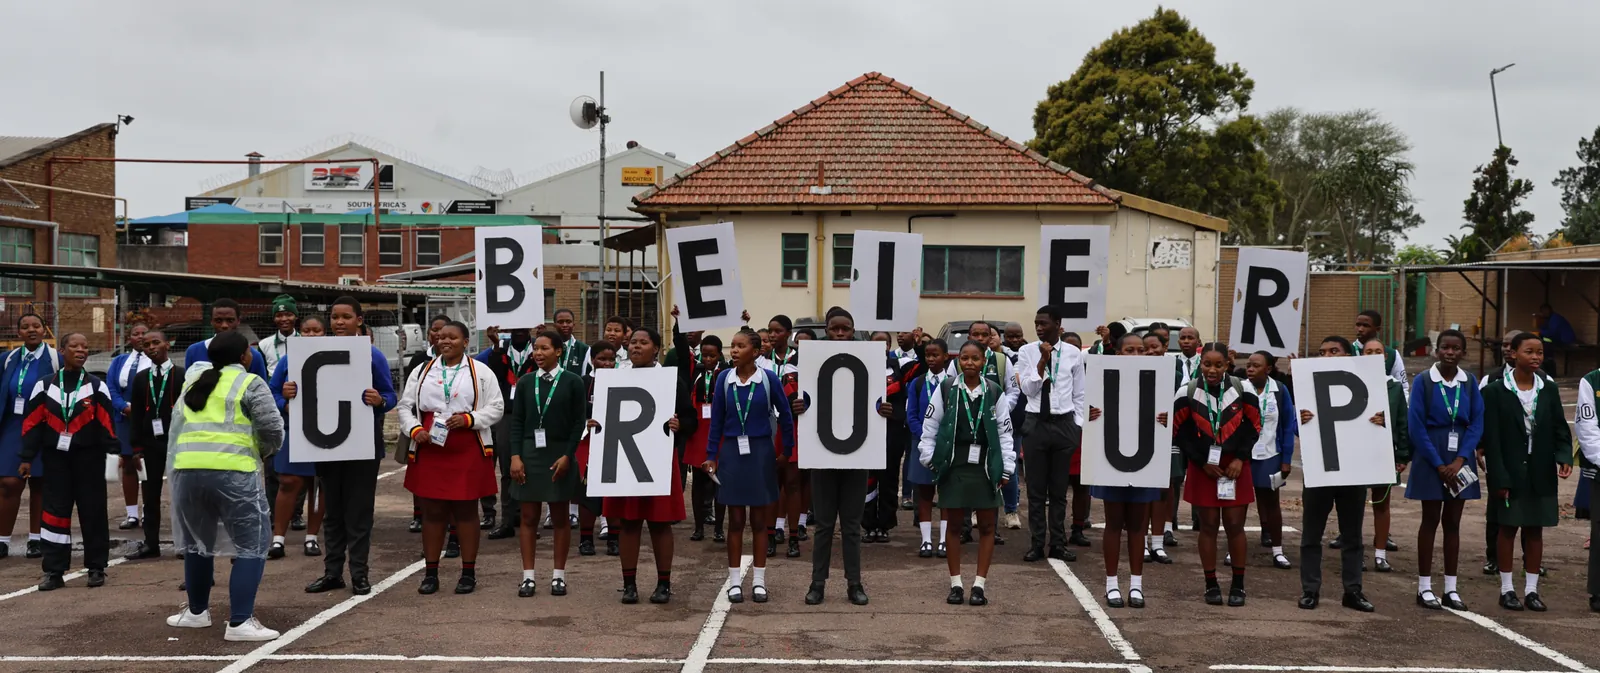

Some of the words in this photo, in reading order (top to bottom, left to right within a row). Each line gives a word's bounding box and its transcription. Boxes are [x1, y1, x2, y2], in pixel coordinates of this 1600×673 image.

[484, 236, 526, 314] B
[677, 237, 728, 320] E
[875, 241, 896, 321] I
[1048, 238, 1091, 319] E
[1240, 265, 1291, 349] R
[300, 350, 352, 450] G
[600, 386, 656, 484] R
[816, 352, 869, 456] O
[1103, 368, 1157, 473] U
[1312, 370, 1369, 473] P
